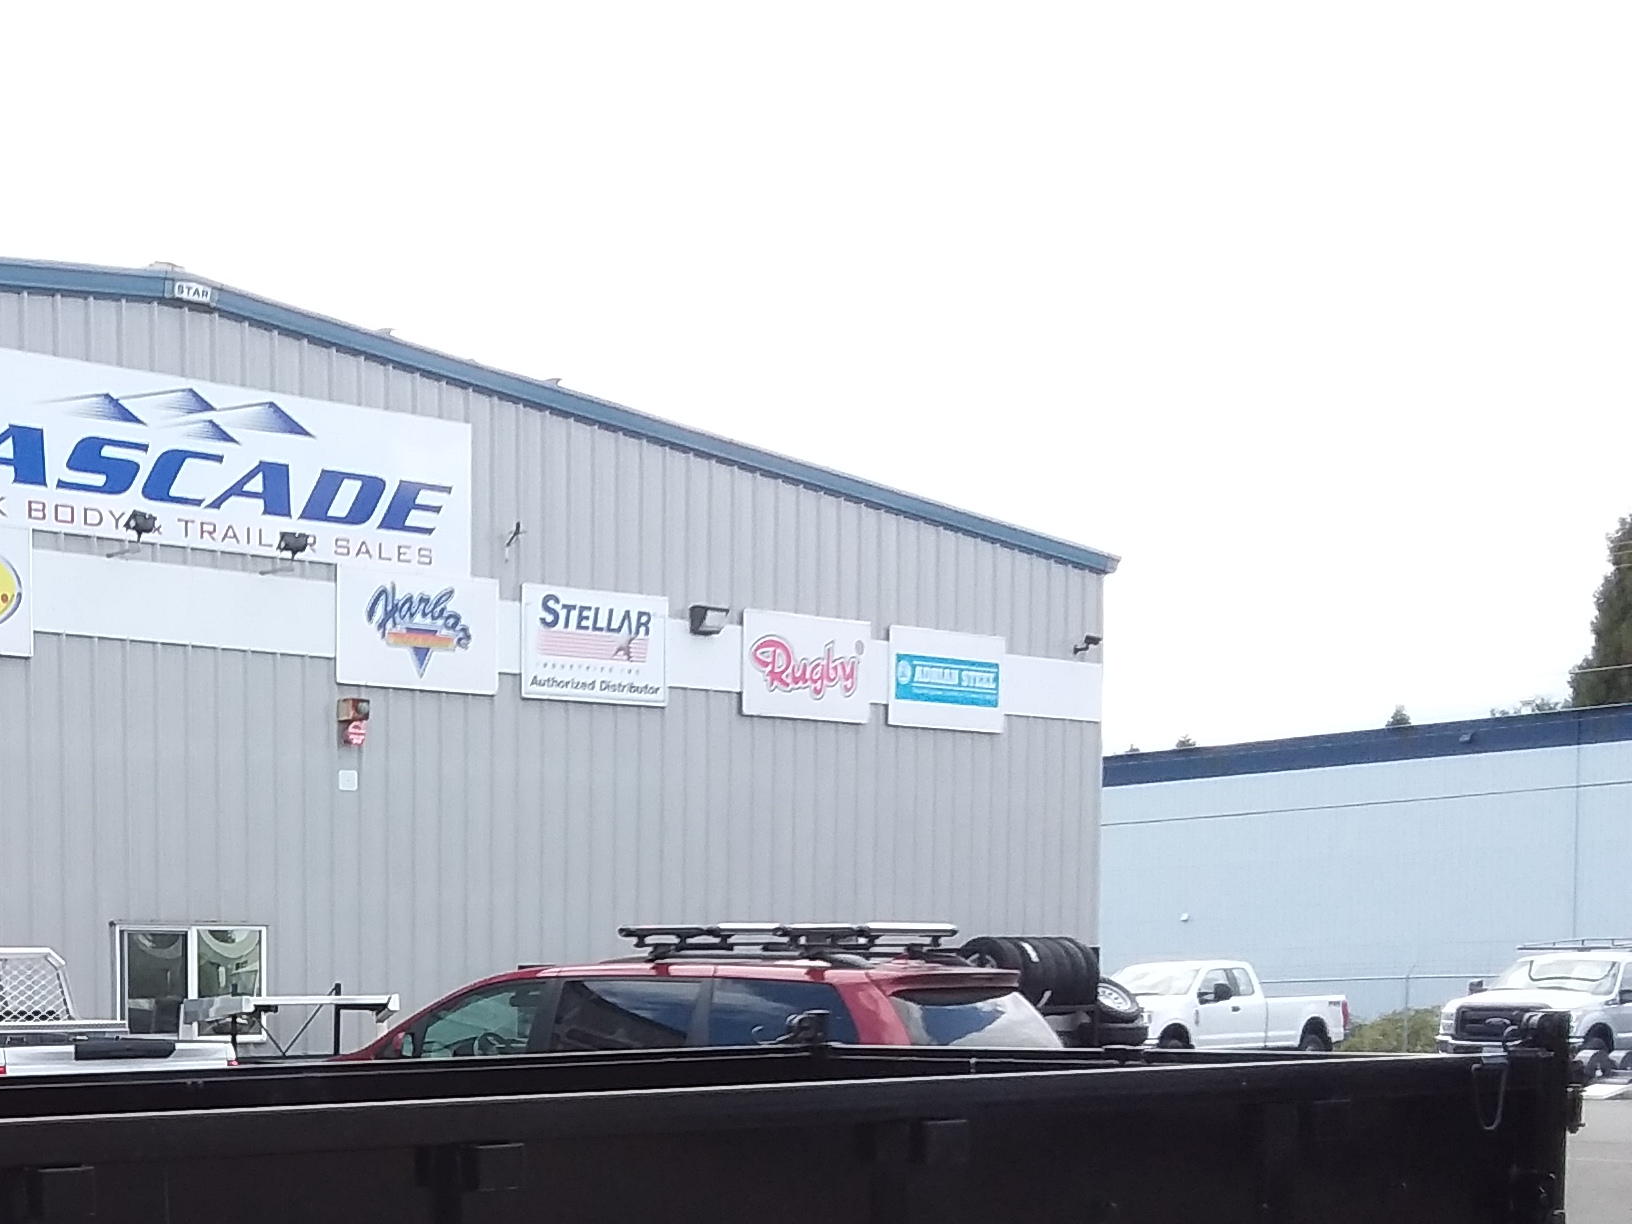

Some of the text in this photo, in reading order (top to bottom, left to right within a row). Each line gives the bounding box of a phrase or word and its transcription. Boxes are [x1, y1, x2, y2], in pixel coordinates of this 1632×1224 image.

[27, 499, 126, 531] BODY
[176, 517, 317, 554] TRAILR
[334, 537, 434, 567] SALES
[538, 593, 652, 637] STELLAR
[529, 675, 662, 696] Authorized Distributor
[750, 635, 858, 699] Rugby
